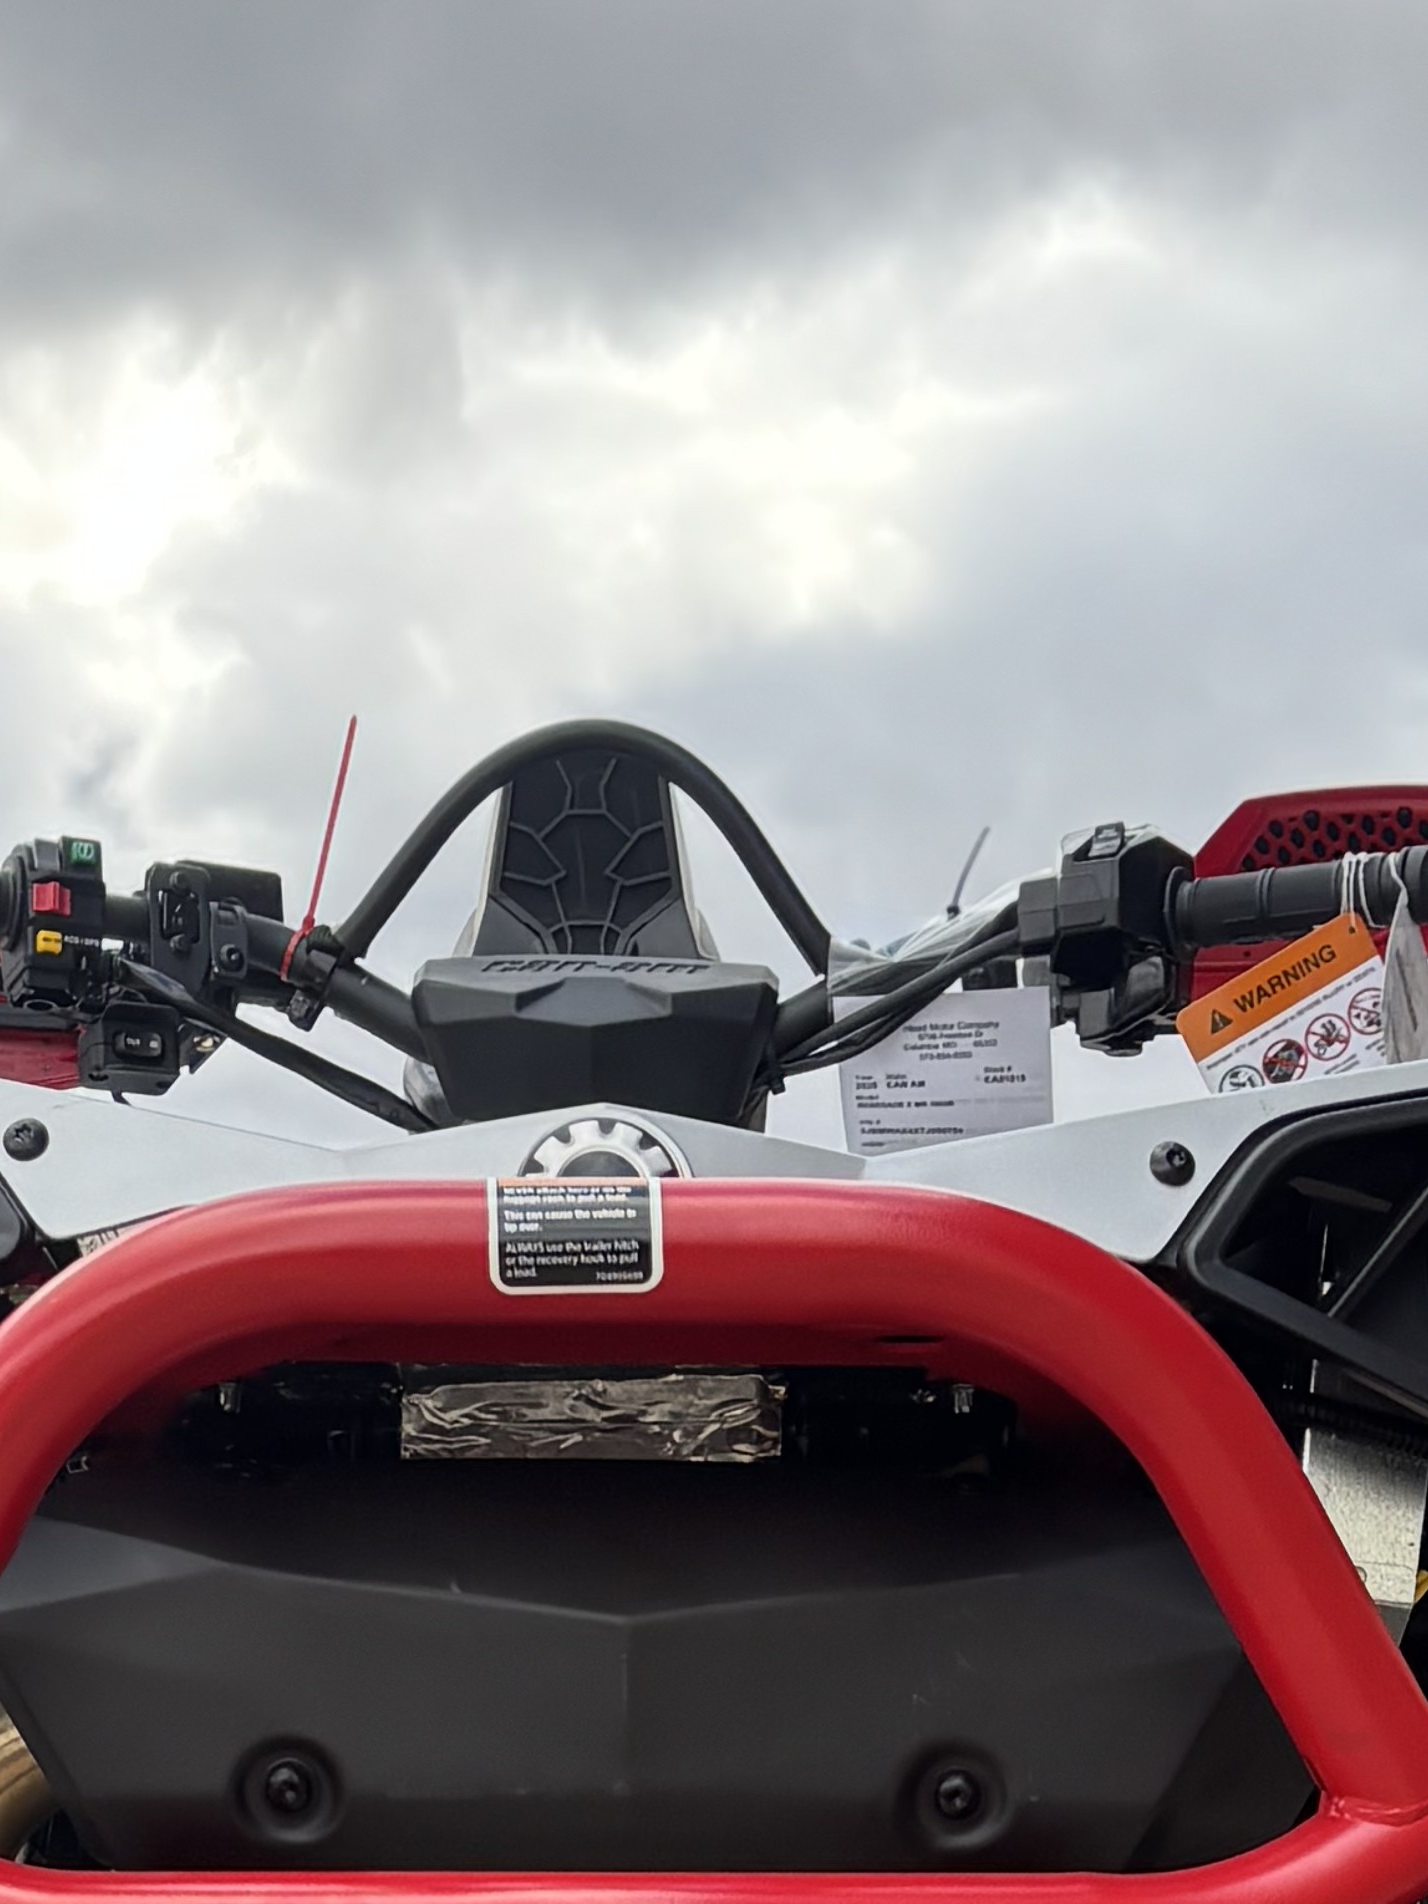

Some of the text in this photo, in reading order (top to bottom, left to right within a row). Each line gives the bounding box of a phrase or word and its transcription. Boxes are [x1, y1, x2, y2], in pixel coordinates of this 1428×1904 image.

[1233, 944, 1336, 1013] WARNING
[957, 1020, 999, 1030] Company
[886, 1080, 908, 1089] CAN
[503, 1208, 637, 1221] This can cause the vehicle to
[518, 1223, 543, 1232] over.
[506, 1239, 640, 1254] ALWAYS use the trailer hitch
[506, 1252, 639, 1266] or the recovery hook to pull
[514, 1265, 537, 1278] load.
